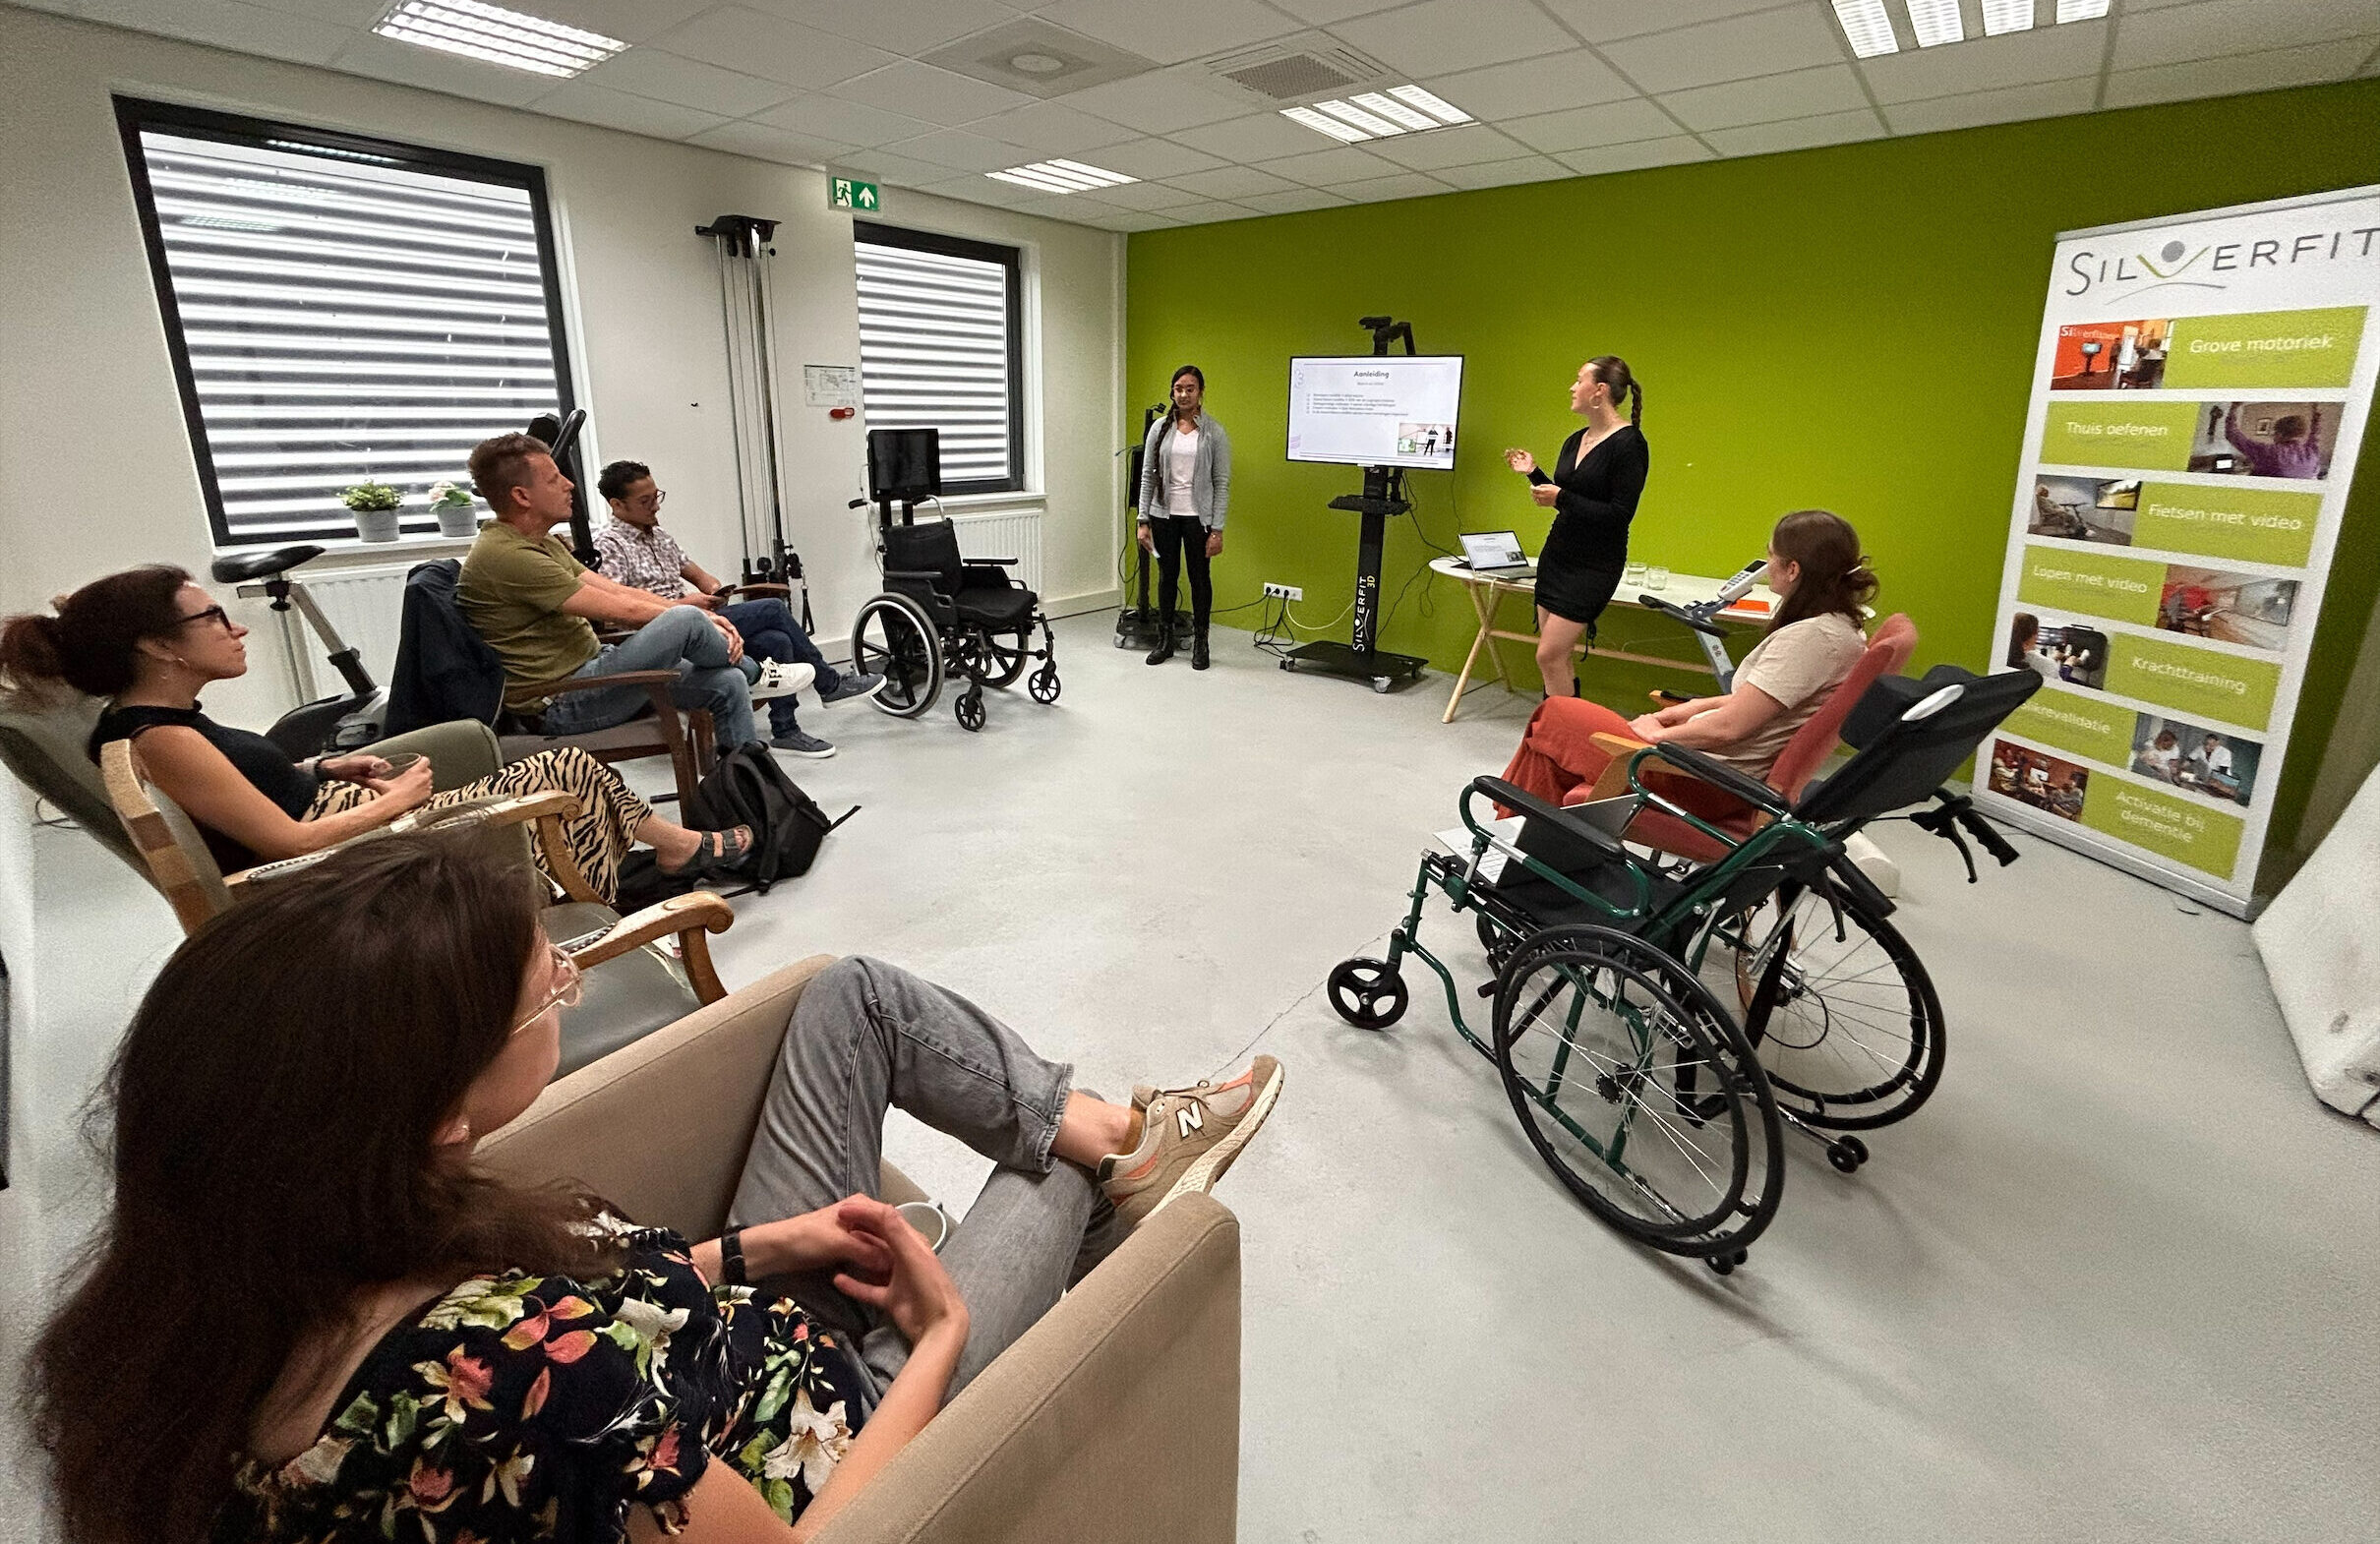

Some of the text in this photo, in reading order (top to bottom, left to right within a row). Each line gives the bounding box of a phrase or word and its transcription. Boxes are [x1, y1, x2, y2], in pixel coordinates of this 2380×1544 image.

[2065, 226, 2380, 297] SILVERFIT
[2189, 333, 2334, 354] Grove motoriek
[1353, 370, 1390, 380] Aanleiding
[2066, 421, 2169, 436] Thuis oefenen
[2148, 503, 2303, 530] Fietsen met video
[1366, 574, 1376, 589] 3D
[2033, 564, 2148, 594] Lopen met video
[2132, 656, 2246, 695] Krachttraining
[2115, 791, 2181, 823] Activatie
[2120, 809, 2193, 844] dementie
[1175, 1099, 1205, 1139] N
